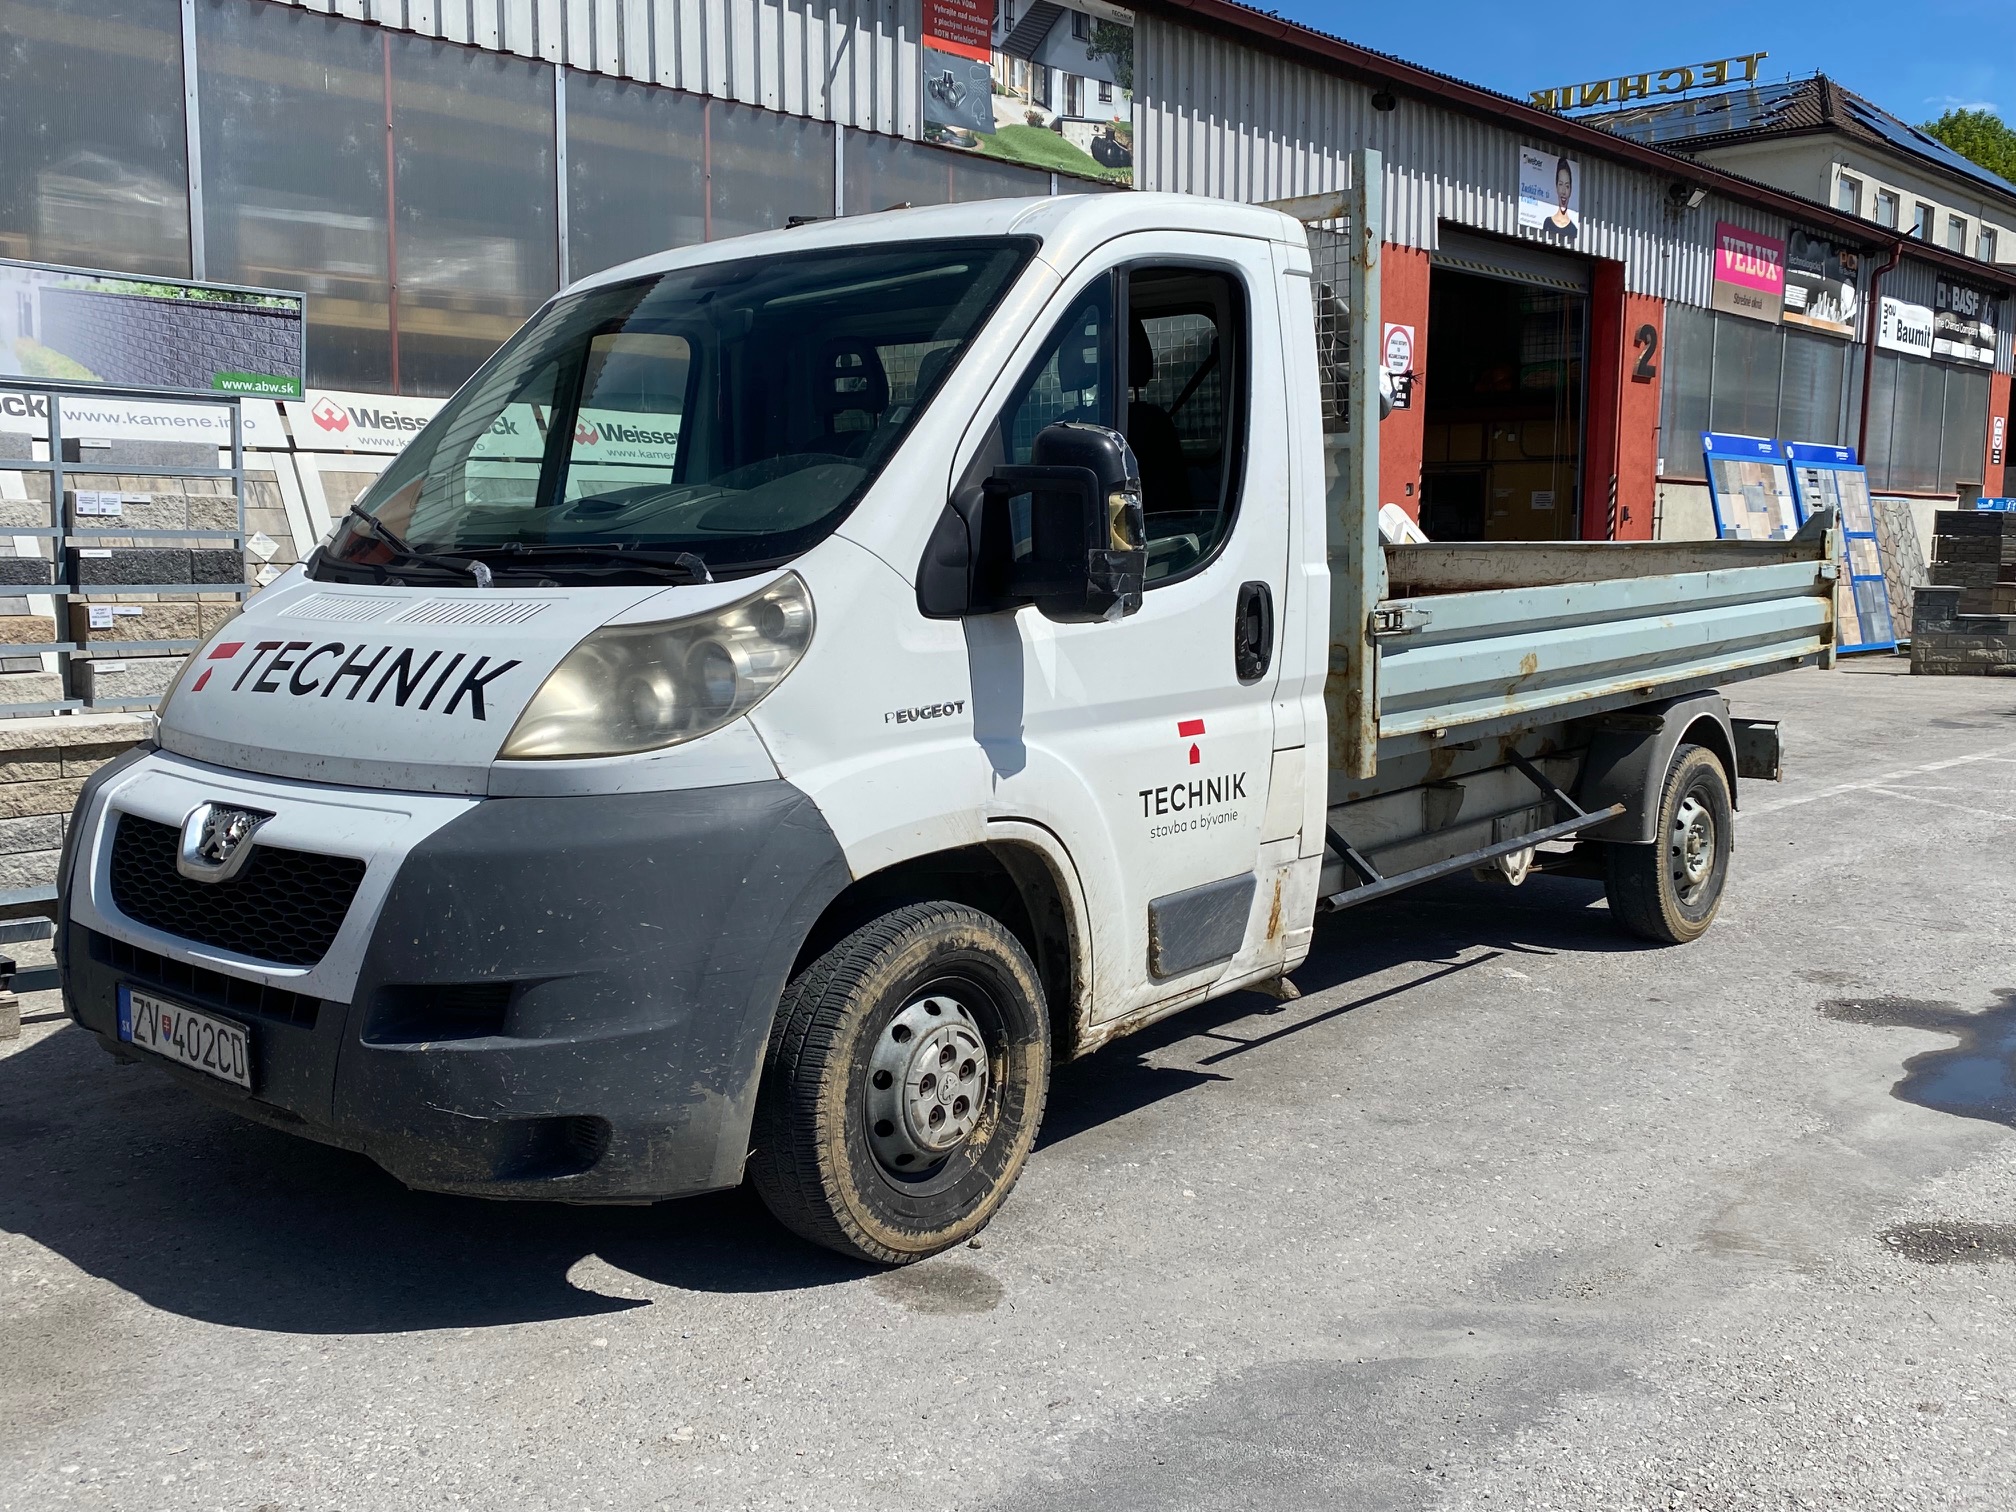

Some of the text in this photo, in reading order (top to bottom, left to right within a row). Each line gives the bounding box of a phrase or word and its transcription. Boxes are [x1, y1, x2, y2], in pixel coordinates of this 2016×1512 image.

[1723, 235, 1779, 282] VELUX
[1952, 285, 1979, 316] BASF
[1896, 318, 1931, 349] Baumit
[1632, 323, 1658, 383] 2
[221, 380, 294, 393] www.abw.sk
[231, 641, 523, 721] TECHNIK
[884, 700, 965, 724] PEUGEOT
[1139, 771, 1246, 818] TECHNIK
[1150, 808, 1238, 839] stavba a bývanie
[121, 1019, 130, 1033] SK
[133, 996, 245, 1079] ZV 402CD
